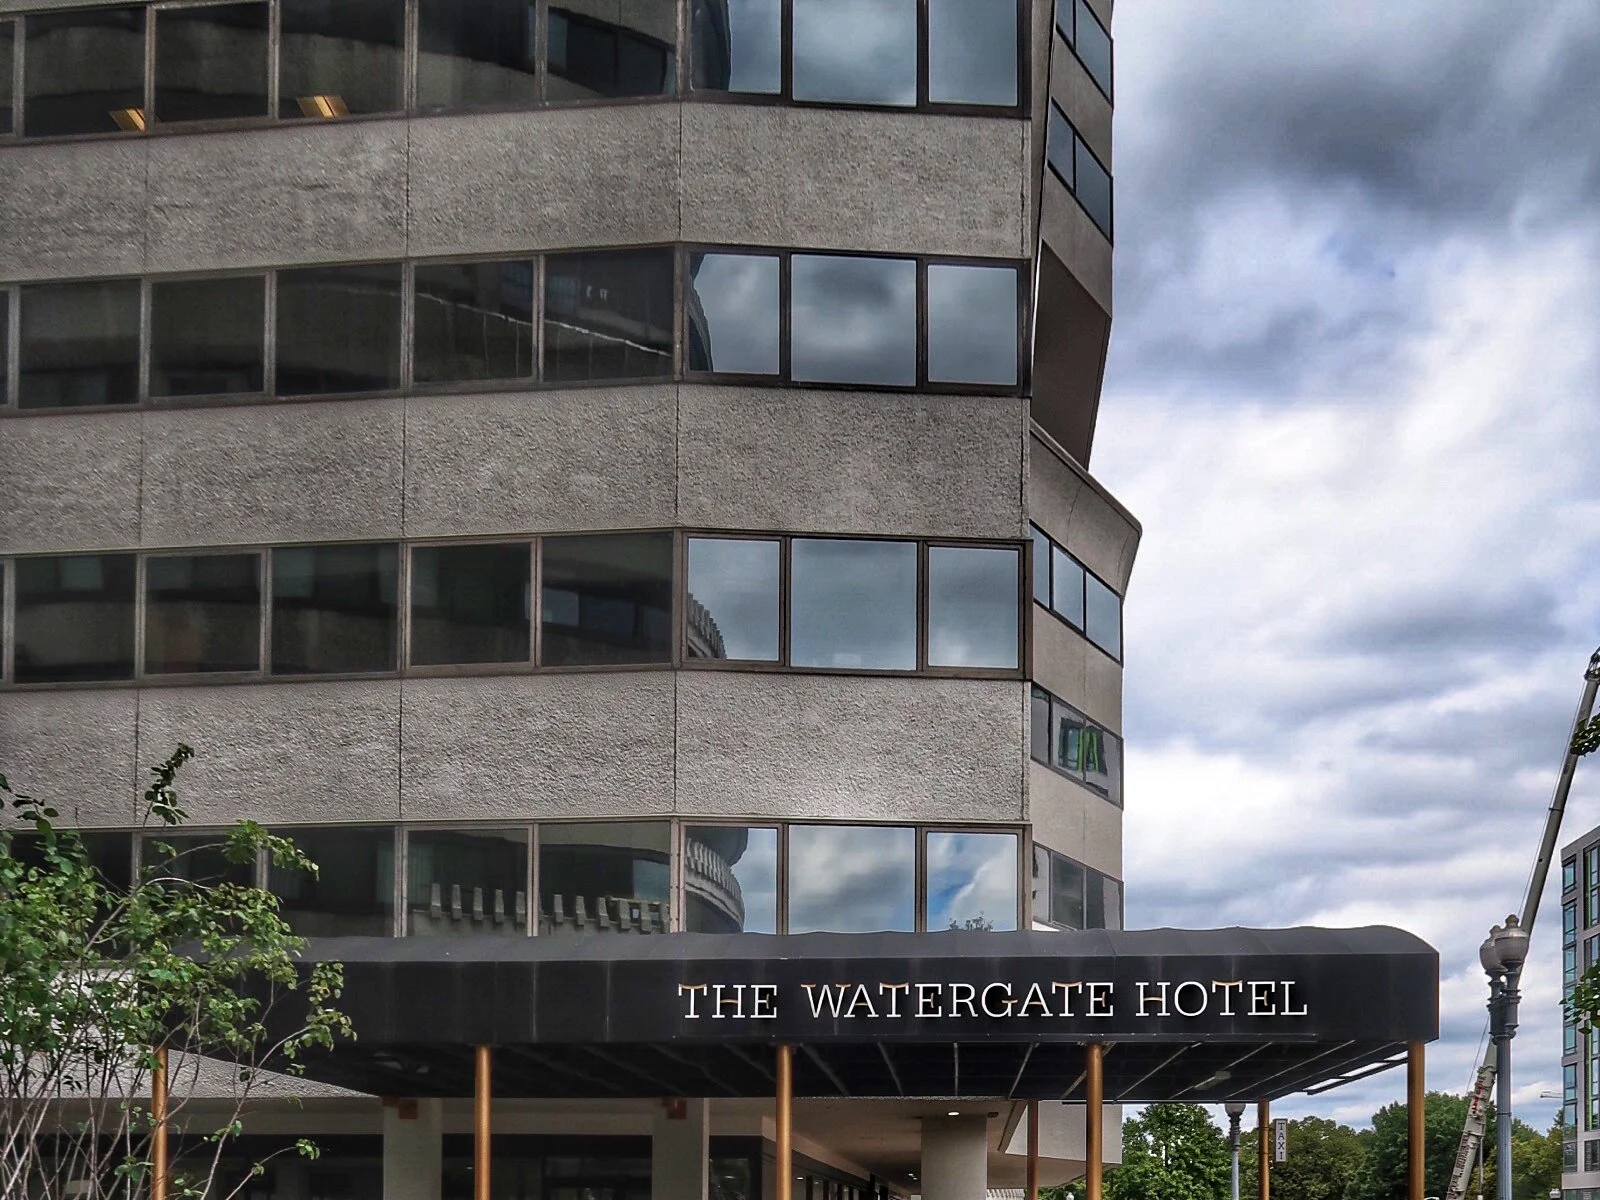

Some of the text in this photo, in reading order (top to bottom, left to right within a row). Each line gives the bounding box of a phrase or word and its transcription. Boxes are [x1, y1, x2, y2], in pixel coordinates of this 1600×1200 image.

[678, 979, 1308, 1019] THE WATERGATE HOTEL
[1277, 1122, 1285, 1160] TAXI
